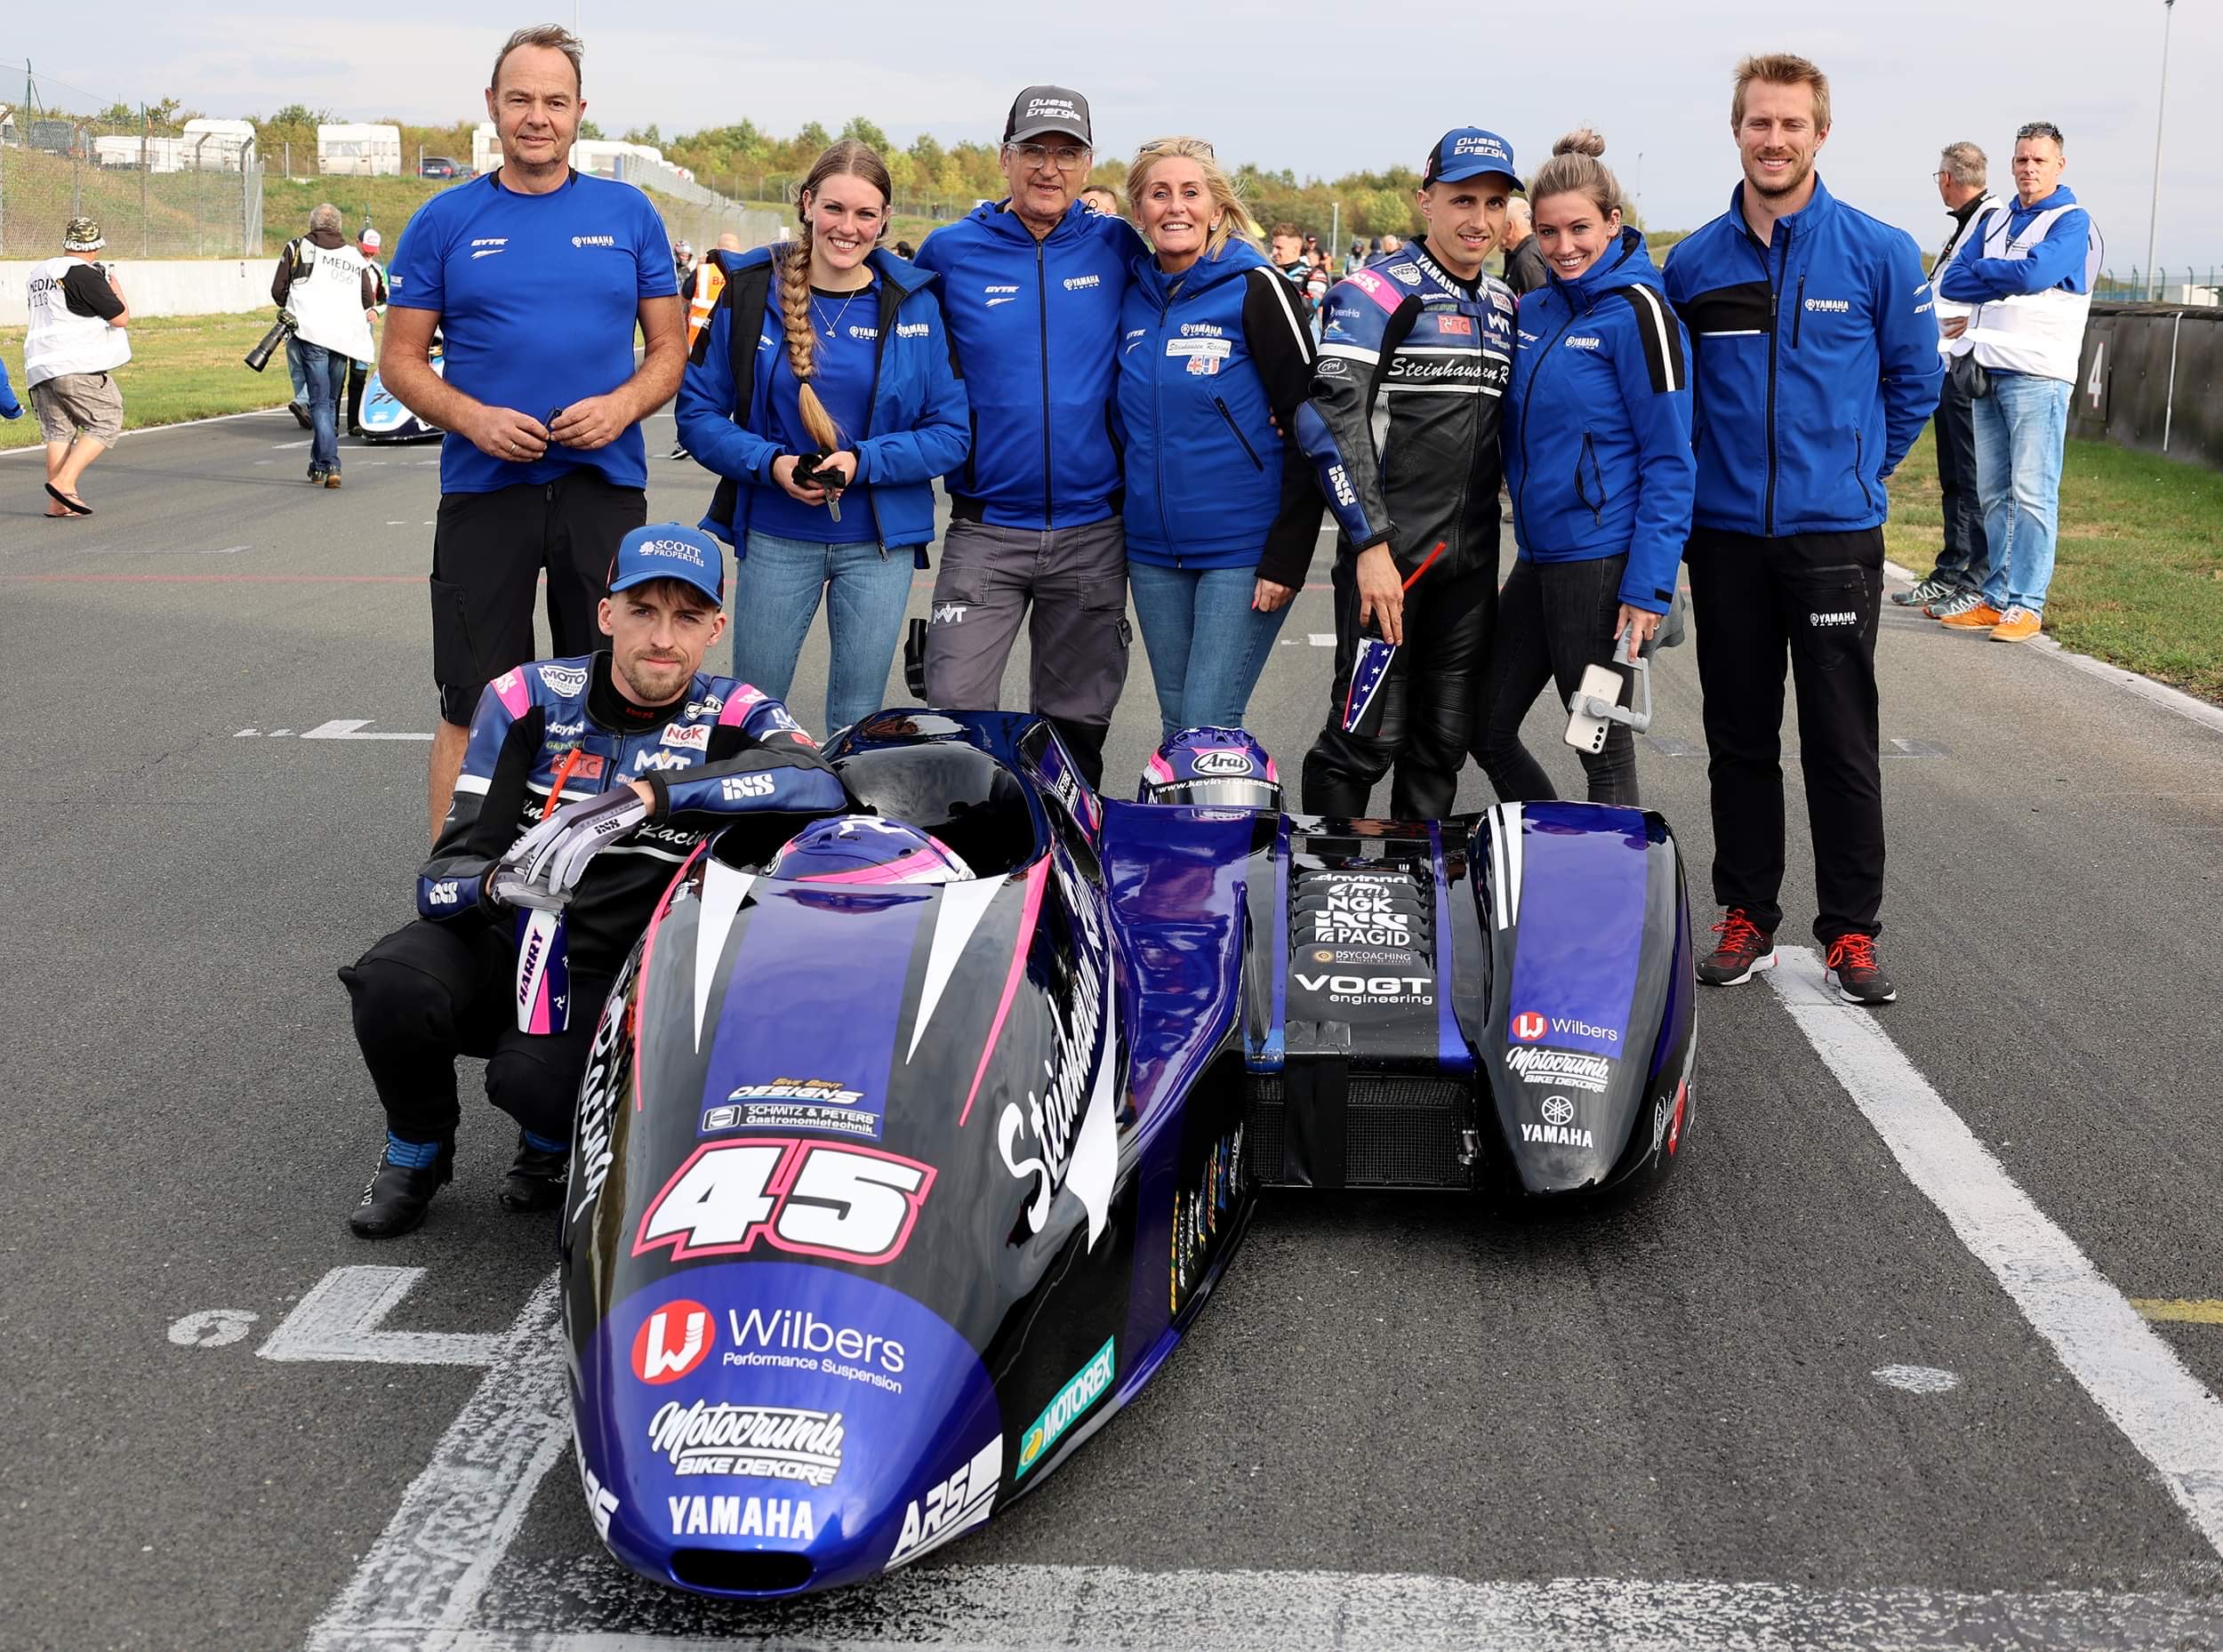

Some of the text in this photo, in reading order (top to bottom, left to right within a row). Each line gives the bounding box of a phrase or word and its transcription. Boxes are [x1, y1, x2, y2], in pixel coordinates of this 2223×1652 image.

[1029, 98, 1073, 108] Quest
[1457, 137, 1502, 148] Quest
[582, 236, 614, 245] YAMAHA
[322, 255, 361, 277] MEDIA
[1072, 275, 1100, 286] YAMAHA
[1416, 253, 1461, 299] YAMAHA
[1815, 300, 1849, 309] YAMAHA
[1190, 324, 1223, 335] YAMAHA
[1388, 357, 1497, 380] Steinhausen
[2087, 341, 2104, 408] 4
[654, 541, 701, 557] SCOTT
[654, 549, 704, 567] PROPERTIES
[1819, 612, 1857, 622] YAMAHA
[543, 670, 585, 685] MOTO
[667, 726, 703, 741] NGK
[1199, 754, 1245, 768] Arai
[1328, 896, 1393, 913] NGK
[1337, 928, 1410, 946] PAGID
[519, 926, 544, 1006] HARRY
[1294, 974, 1432, 994] VOGT
[1329, 994, 1433, 1006] engineering
[1552, 1018, 1617, 1041] Wilbers
[1524, 1074, 1554, 1086] BIKE
[728, 1086, 864, 1105] DESIGNS
[746, 1115, 873, 1134] Gastronomietechnik
[748, 1105, 874, 1125] SCHMITZ & PETERS
[1521, 1123, 1593, 1148] YAMAHA
[635, 1142, 932, 1259] 45
[728, 1308, 905, 1374] Wilbers
[722, 1351, 903, 1394] Performance Suspension
[1042, 1354, 1112, 1447] MOTOREX
[675, 1456, 734, 1476] BIKE
[668, 1496, 815, 1541] YAMAHA
